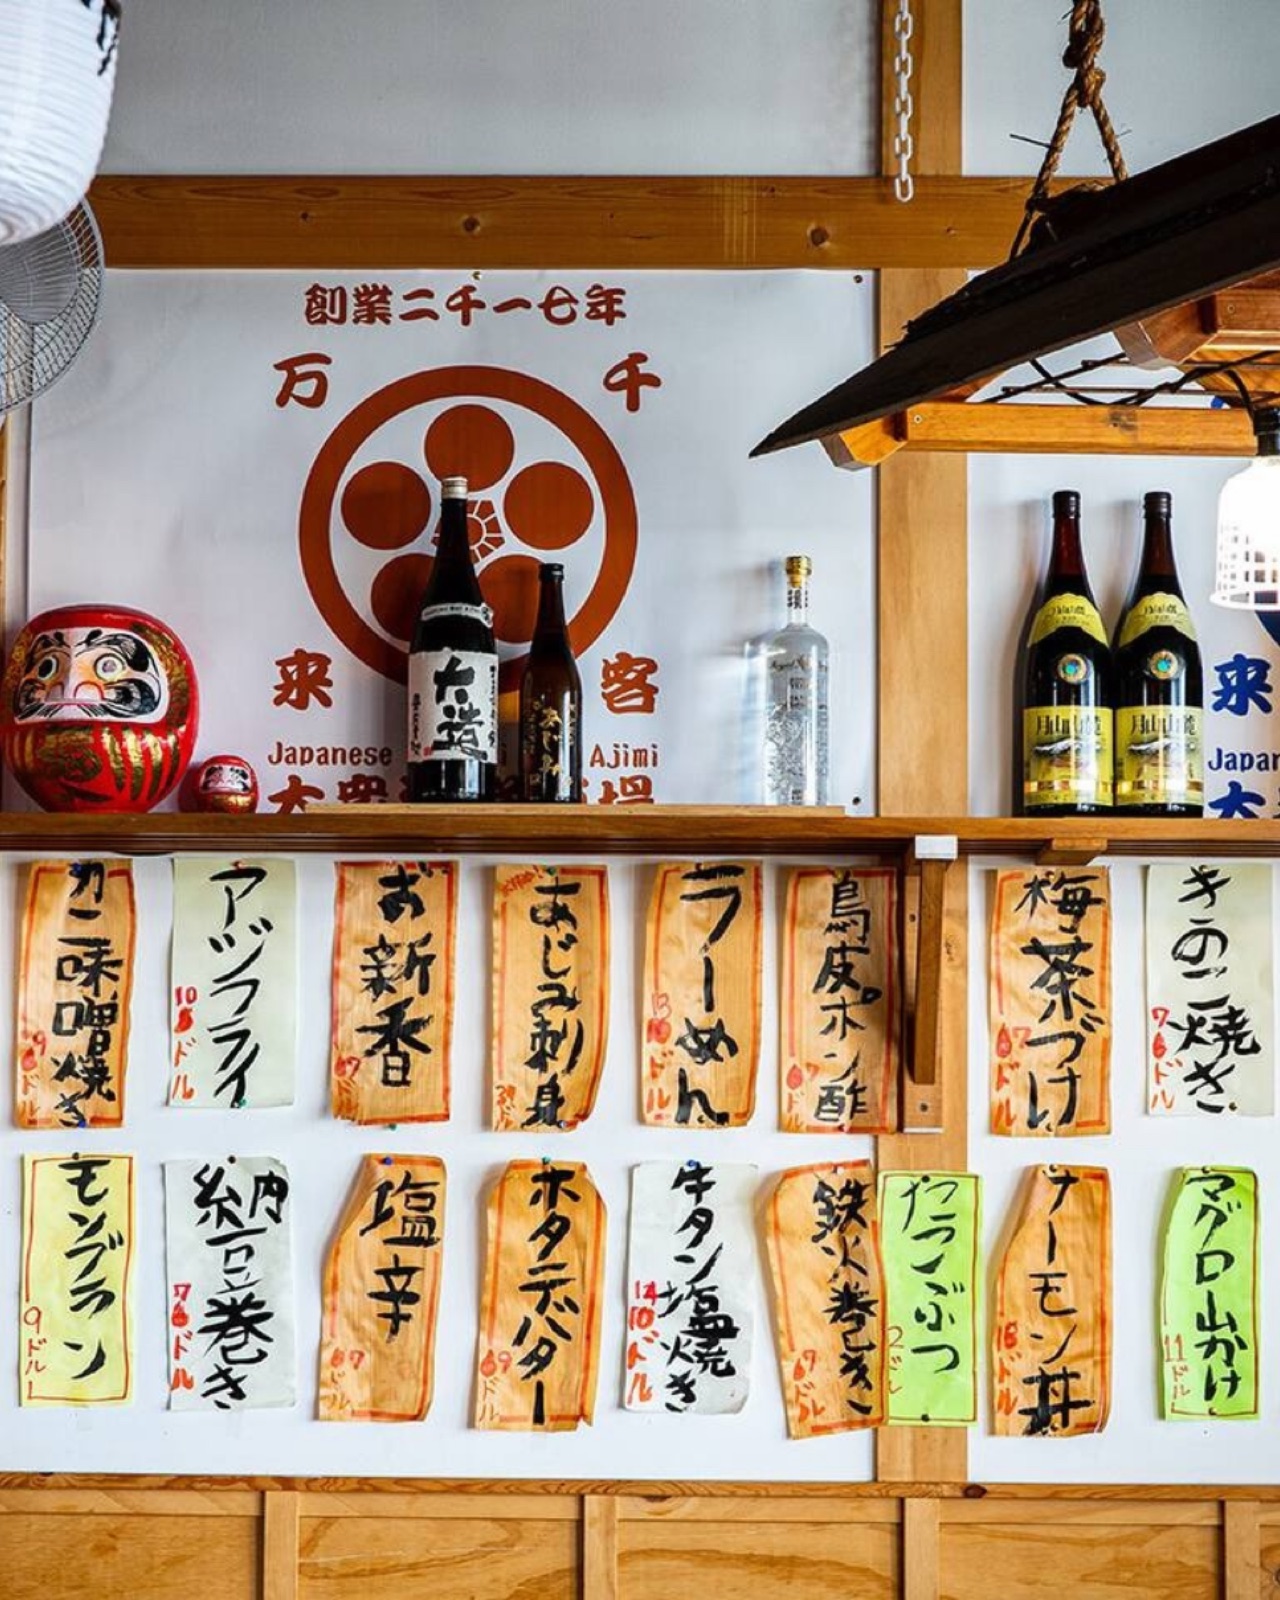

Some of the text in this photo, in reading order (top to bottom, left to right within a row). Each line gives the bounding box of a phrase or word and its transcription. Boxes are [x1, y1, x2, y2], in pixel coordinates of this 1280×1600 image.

[305, 284, 626, 326] 創業二千一七年
[273, 353, 332, 407] 万
[603, 352, 662, 412] 千
[273, 649, 334, 711] 来
[601, 652, 660, 715] 客
[1213, 653, 1273, 716] 来
[268, 741, 659, 768] Japanese Ajimi
[1167, 866, 1262, 1113] きのこ焼き
[58, 1159, 124, 1380] モンブラン
[193, 1163, 289, 1410] 納豆巻き
[359, 1170, 441, 1344] 塩辛
